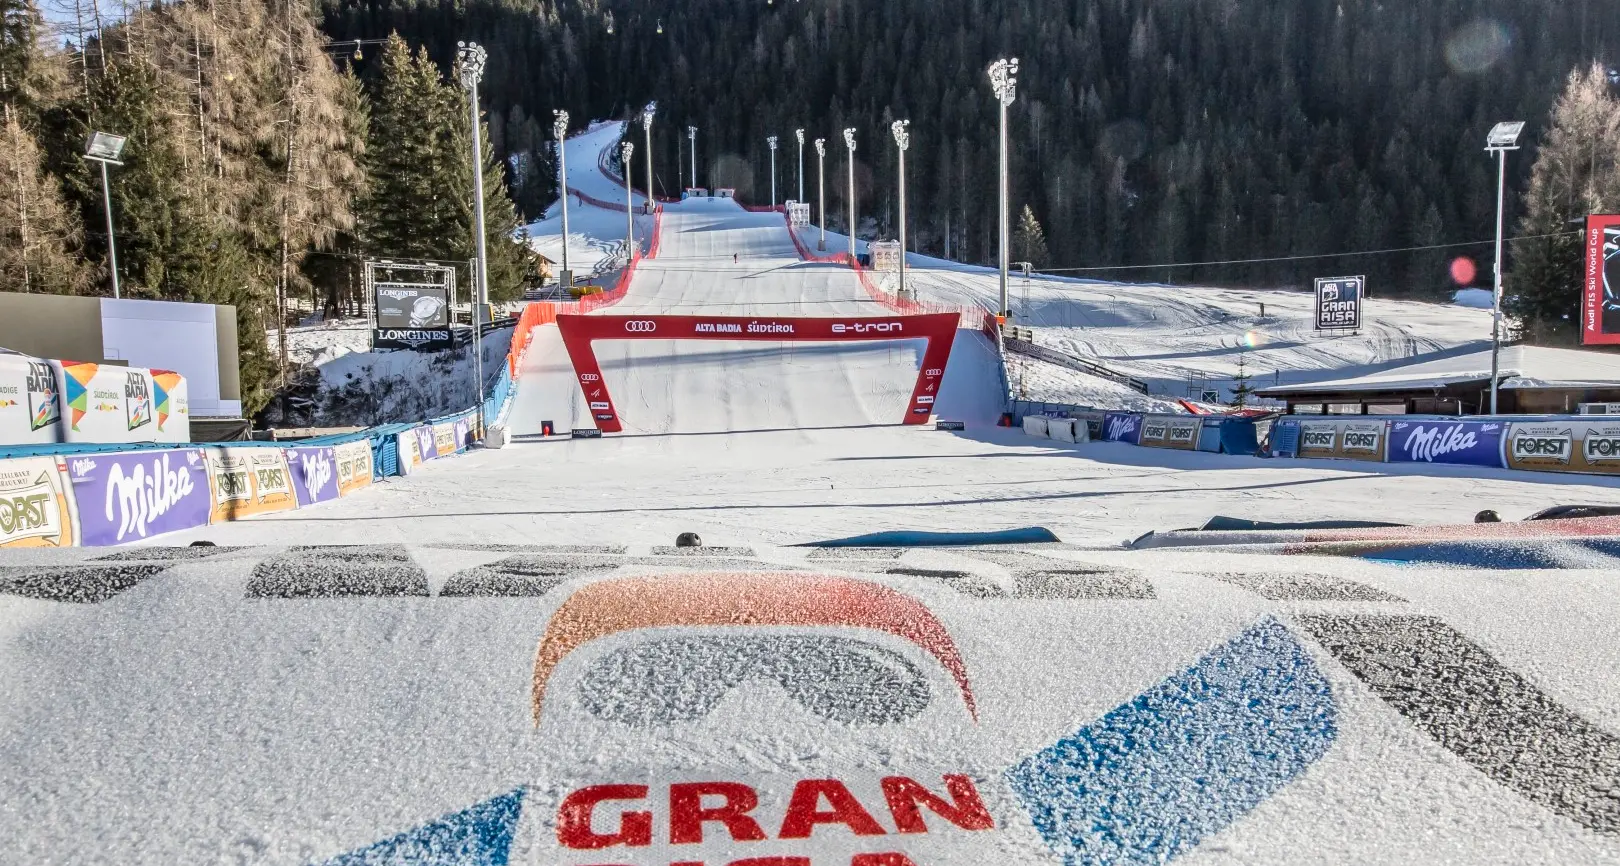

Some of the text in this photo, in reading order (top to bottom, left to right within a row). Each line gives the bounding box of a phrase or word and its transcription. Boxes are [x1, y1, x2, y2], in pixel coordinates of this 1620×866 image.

[1590, 228, 1599, 245] Cup
[1589, 247, 1597, 274] World
[1588, 278, 1596, 291] Ski
[379, 289, 418, 297] LONGINES
[1321, 301, 1355, 312] GRAN
[1587, 308, 1595, 331] Audi
[695, 323, 716, 332] ALTA
[716, 323, 742, 333] BADIA
[831, 322, 903, 333] e-tron
[378, 330, 449, 341] LONGINES
[126, 371, 146, 386] ALTA
[125, 384, 150, 399] BADIA
[1145, 426, 1165, 437] FORST
[1172, 427, 1193, 439] FORST
[1304, 432, 1335, 446] FORST
[1344, 432, 1377, 447] FORST
[1404, 424, 1478, 463] Milka
[1516, 437, 1569, 455] FORST
[72, 457, 97, 477] Milka
[217, 472, 248, 497] FORST
[257, 468, 286, 490] FORST
[105, 452, 195, 541] Milka
[556, 773, 995, 850] GRAN
